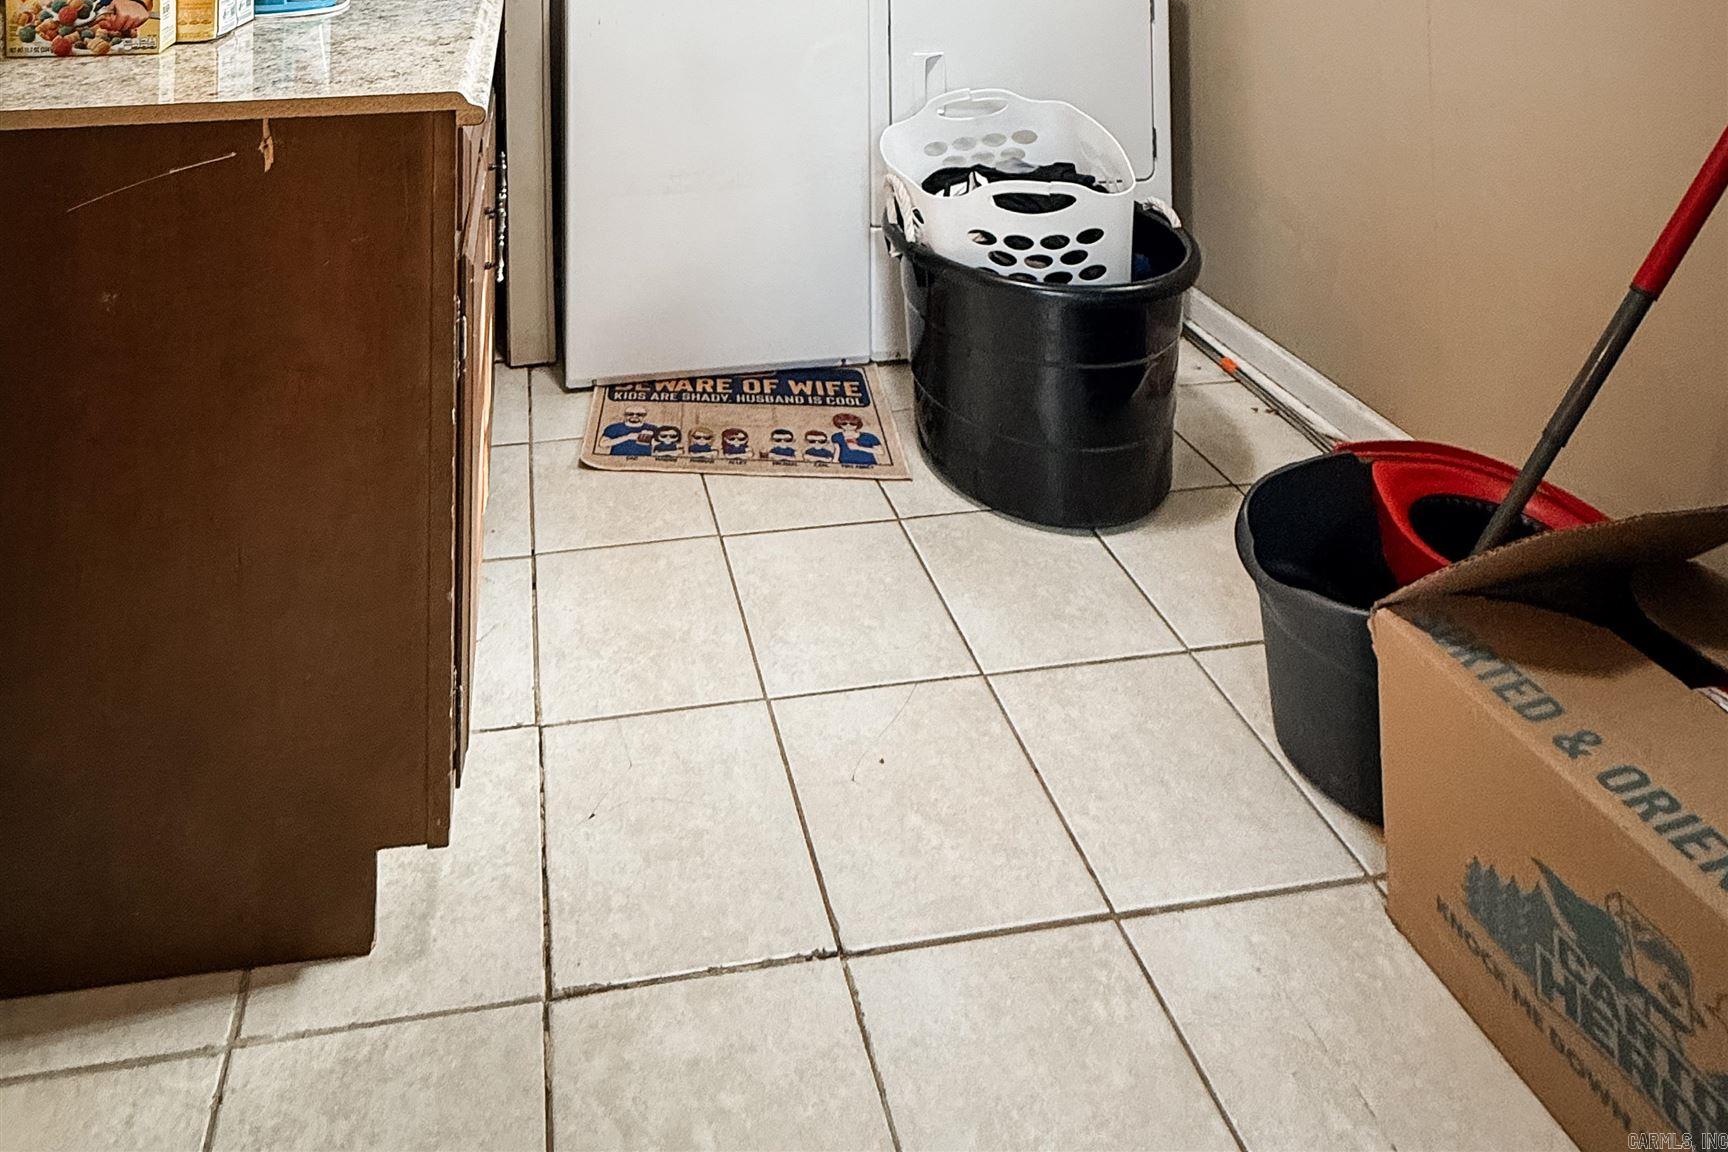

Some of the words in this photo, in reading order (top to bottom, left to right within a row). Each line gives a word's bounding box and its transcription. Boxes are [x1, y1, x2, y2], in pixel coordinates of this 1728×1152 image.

[742, 378, 779, 394] OF
[788, 379, 863, 397] WIFE
[613, 391, 647, 401] KIDS
[650, 391, 679, 401] ARE
[736, 394, 804, 404] HUSBAND
[808, 395, 822, 405] IS
[826, 396, 865, 406] COOL
[1551, 728, 1603, 760] &
